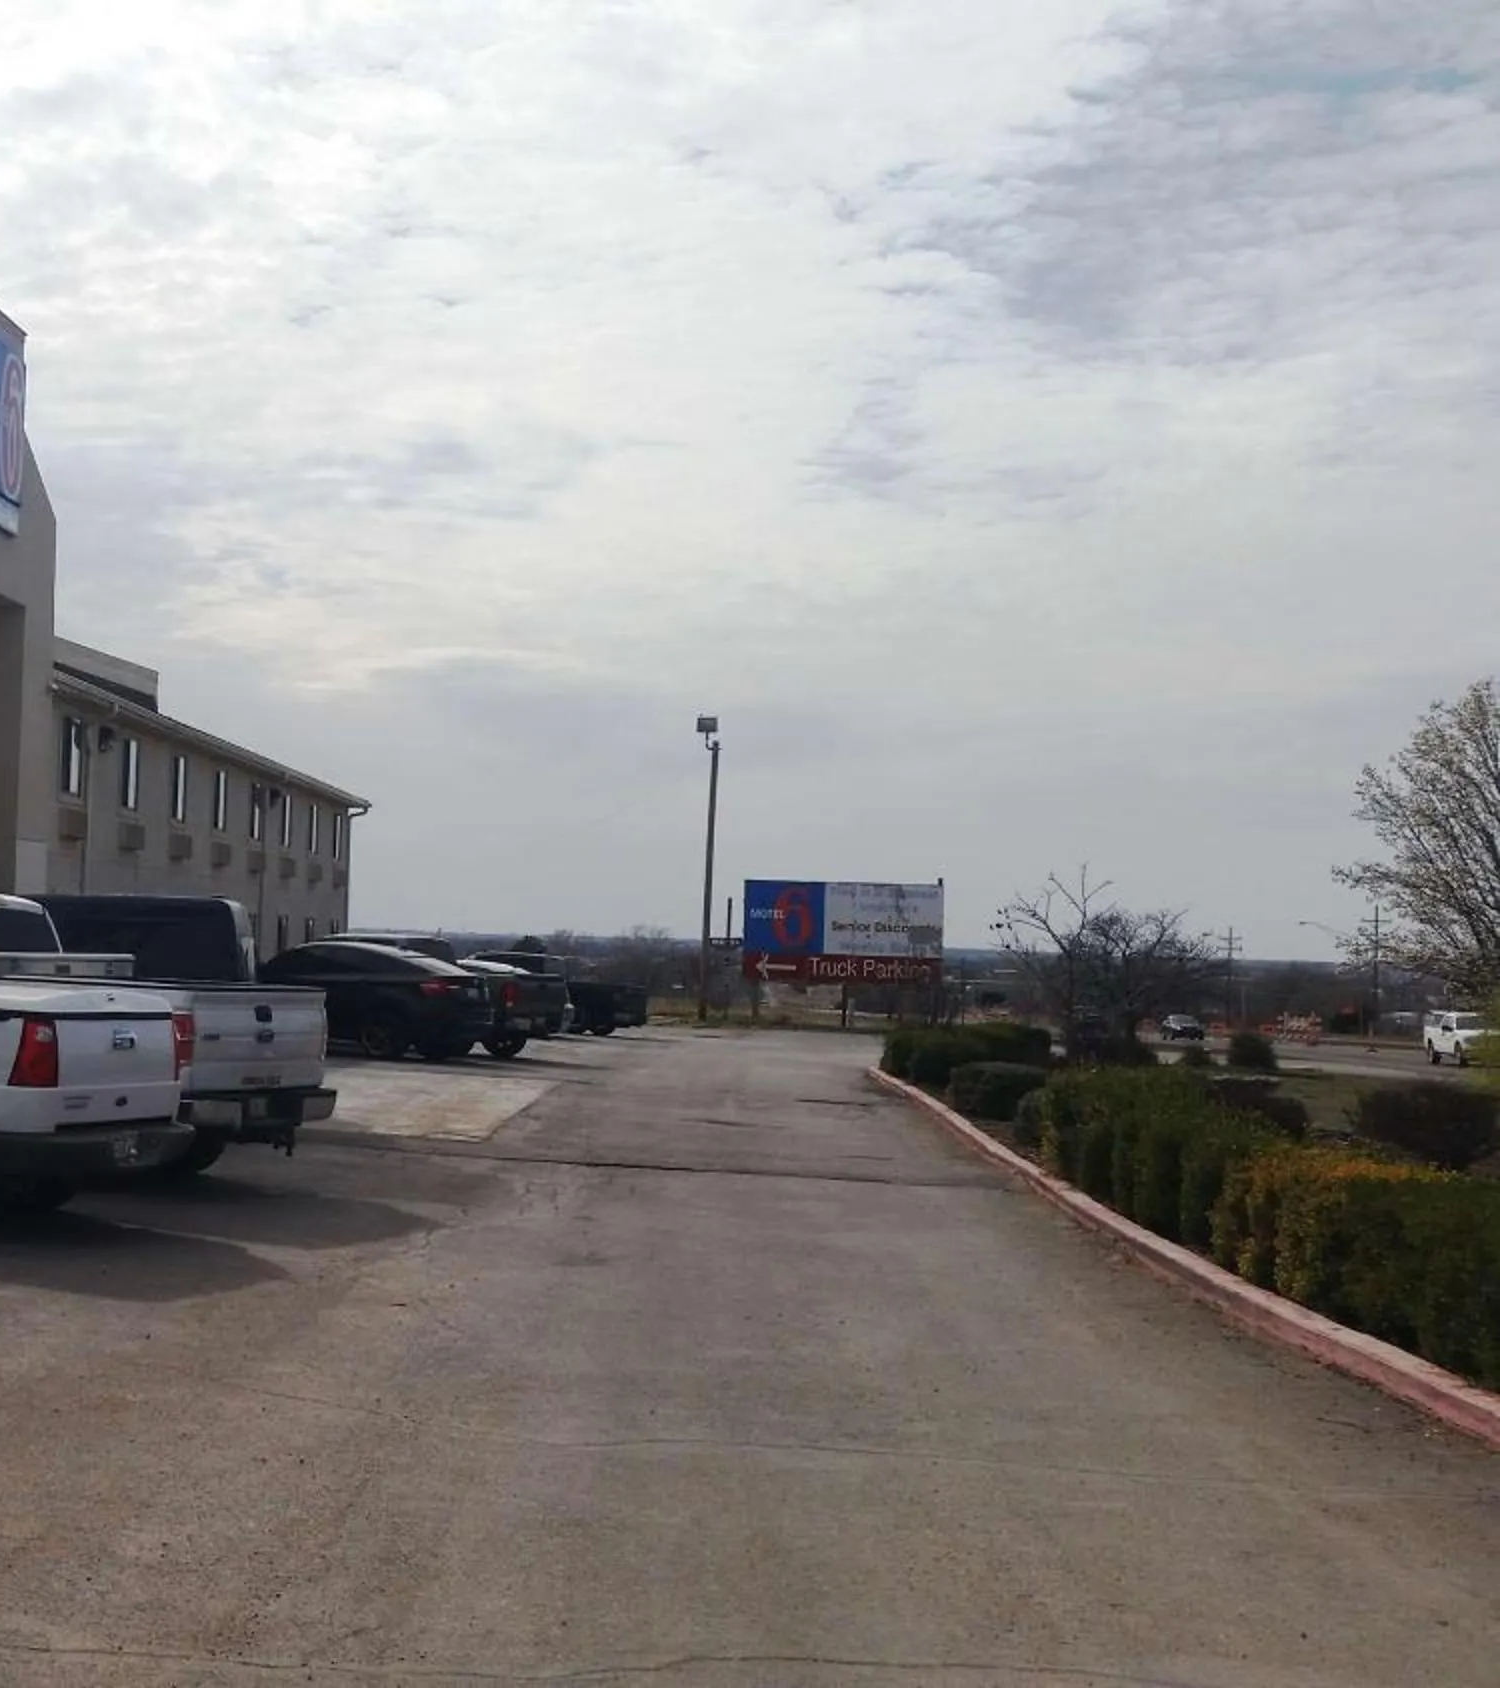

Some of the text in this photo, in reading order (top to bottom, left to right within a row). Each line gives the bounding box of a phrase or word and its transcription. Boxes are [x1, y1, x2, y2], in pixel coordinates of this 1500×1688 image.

[0, 353, 25, 499] 6
[750, 907, 787, 920] MOTEL
[772, 885, 814, 949] 6
[810, 957, 931, 980] Truck Parking
